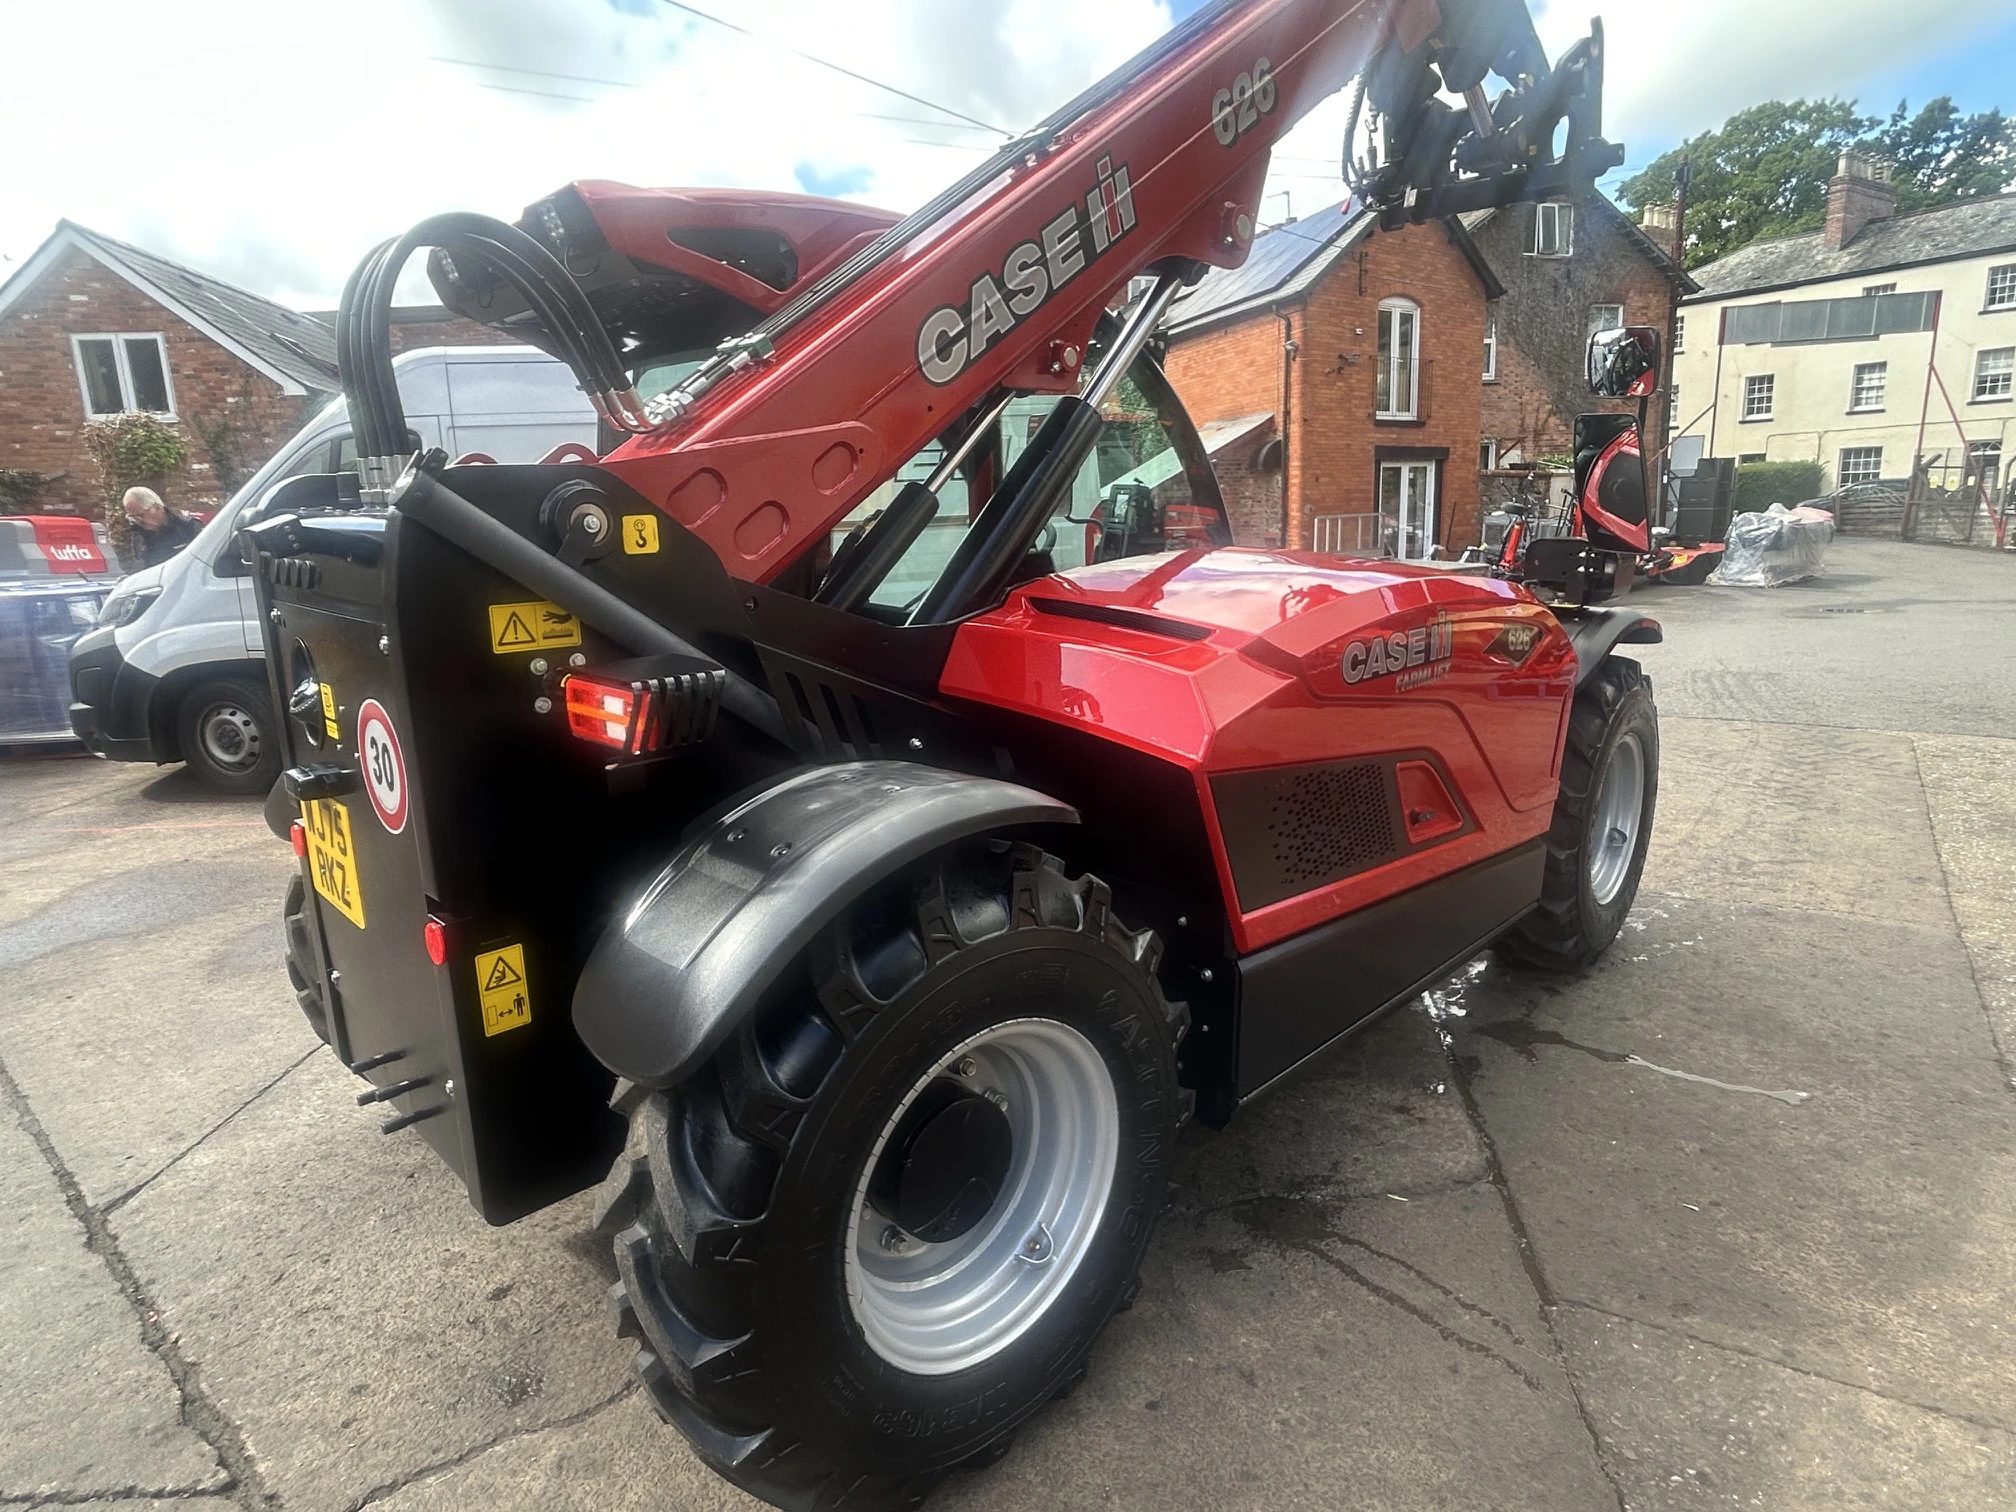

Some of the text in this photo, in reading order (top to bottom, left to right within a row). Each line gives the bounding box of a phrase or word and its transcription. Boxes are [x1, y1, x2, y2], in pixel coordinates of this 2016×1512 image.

[1212, 56, 1275, 146] 626
[917, 206, 1086, 384] CASE
[49, 544, 93, 560] tuffa
[1342, 626, 1427, 684] CASE
[1508, 628, 1531, 651] 626
[1395, 662, 1451, 694] FARMLIFT
[369, 736, 395, 791] 30
[315, 845, 352, 910] RKZ
